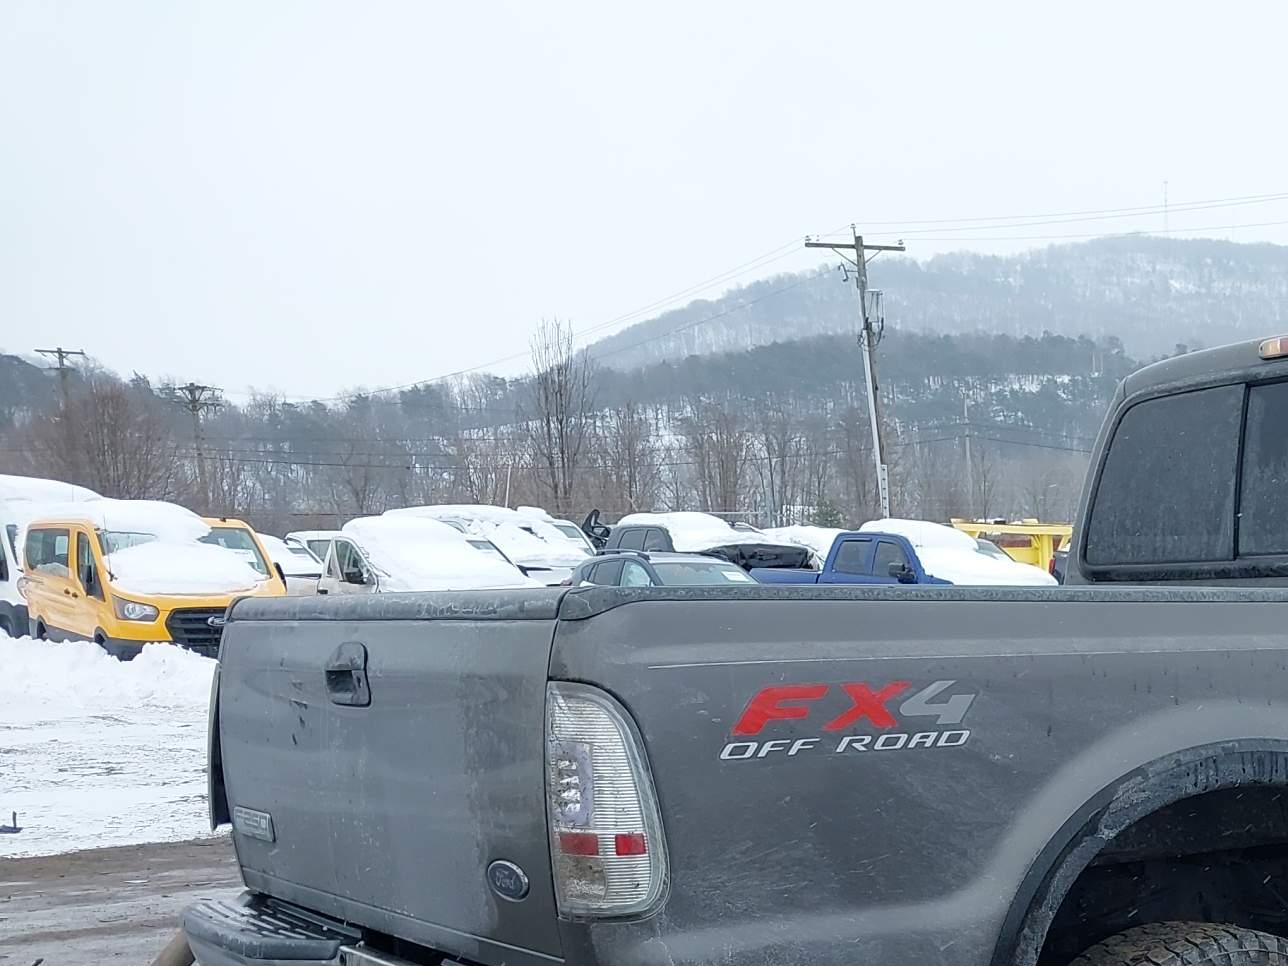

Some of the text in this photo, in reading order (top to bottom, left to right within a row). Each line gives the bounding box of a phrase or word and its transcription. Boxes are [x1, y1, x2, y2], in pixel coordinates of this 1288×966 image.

[731, 679, 977, 736] FX4
[718, 729, 972, 760] OFF ROAD
